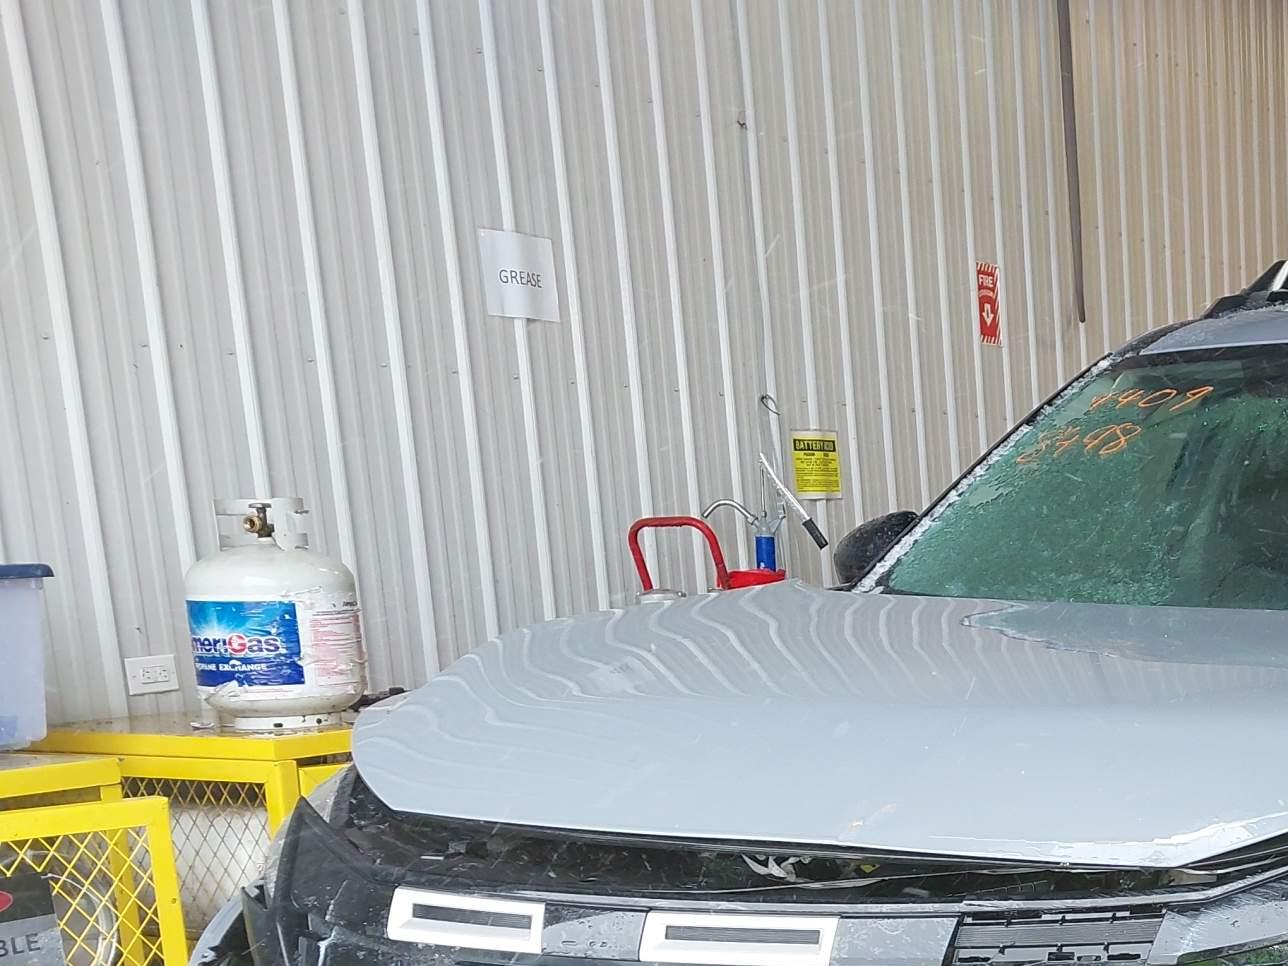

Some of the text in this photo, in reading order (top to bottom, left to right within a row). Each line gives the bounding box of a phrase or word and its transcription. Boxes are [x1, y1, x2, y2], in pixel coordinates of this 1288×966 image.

[499, 269, 543, 289] GREASE
[978, 274, 994, 288] FIRE
[795, 440, 824, 451] BATTERY
